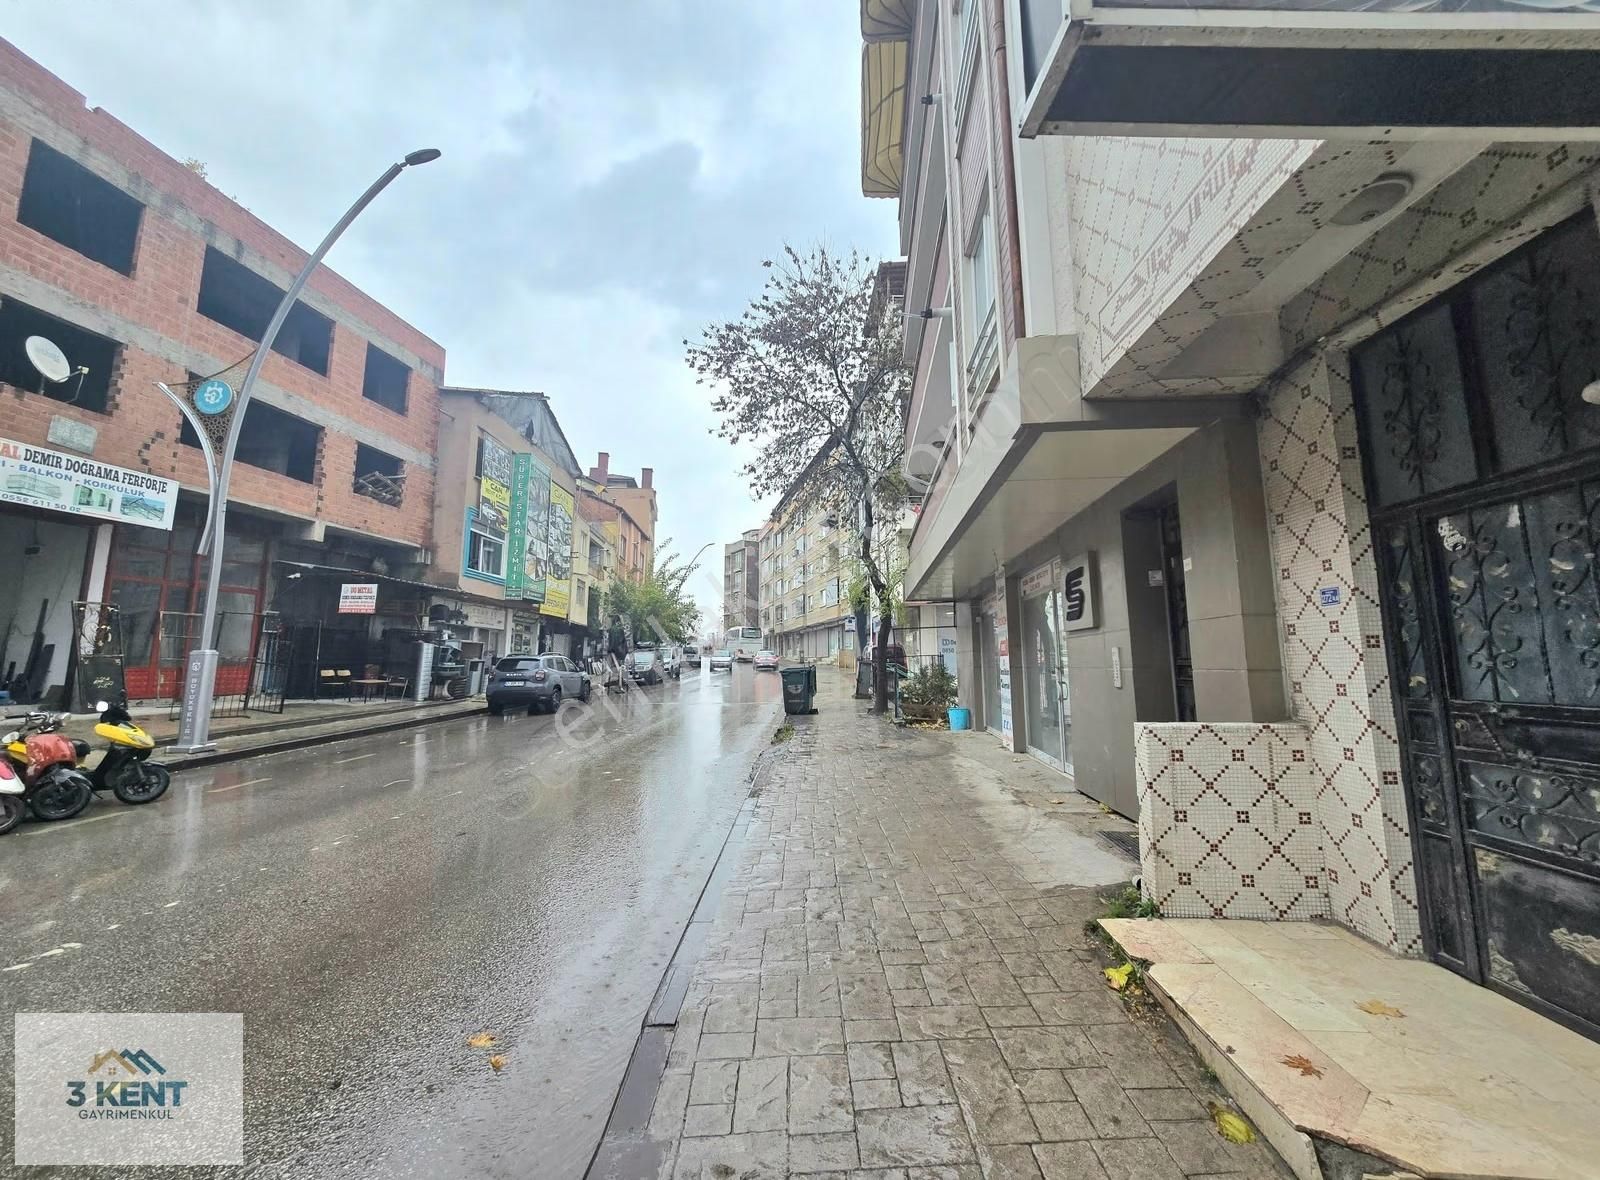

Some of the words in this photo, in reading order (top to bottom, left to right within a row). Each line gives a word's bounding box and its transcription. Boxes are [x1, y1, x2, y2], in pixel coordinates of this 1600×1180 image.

[19, 464, 73, 482] BALKON
[83, 478, 145, 497] KORKULUK
[24, 448, 62, 469] DEMİR
[65, 459, 120, 482] DOĞRAMA
[122, 471, 168, 494] FERFORJE
[516, 458, 527, 497] SUPER
[1, 493, 29, 503] 0552
[32, 499, 50, 507] 611
[514, 503, 523, 534] STAR
